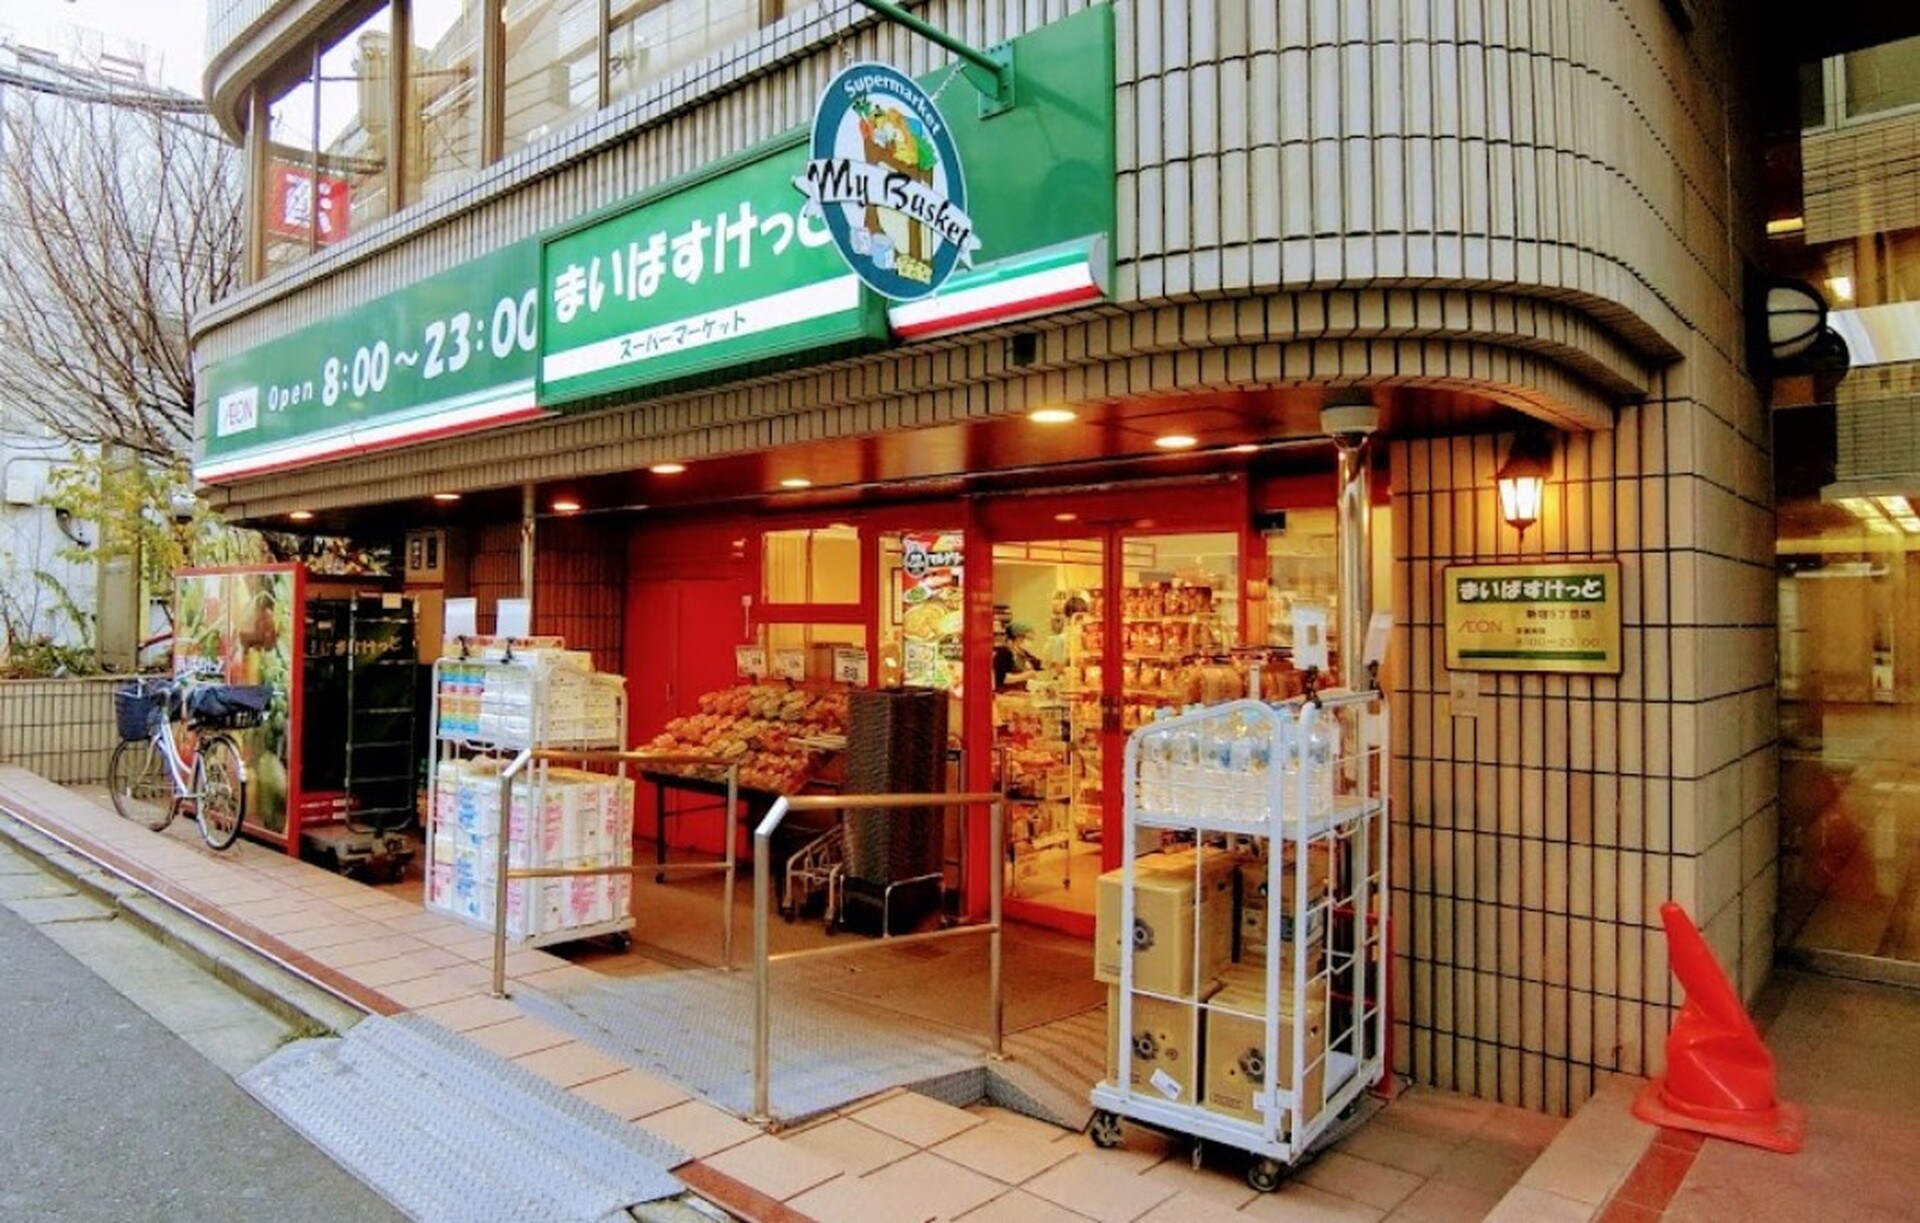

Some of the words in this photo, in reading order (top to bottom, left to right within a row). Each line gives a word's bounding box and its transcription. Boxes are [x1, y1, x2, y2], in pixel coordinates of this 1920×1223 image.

[844, 74, 940, 134] Supermarket
[808, 159, 870, 208] My
[620, 310, 746, 360] スーパーマーケット
[268, 381, 312, 411] Open
[1459, 579, 1602, 600] まいばすけっと
